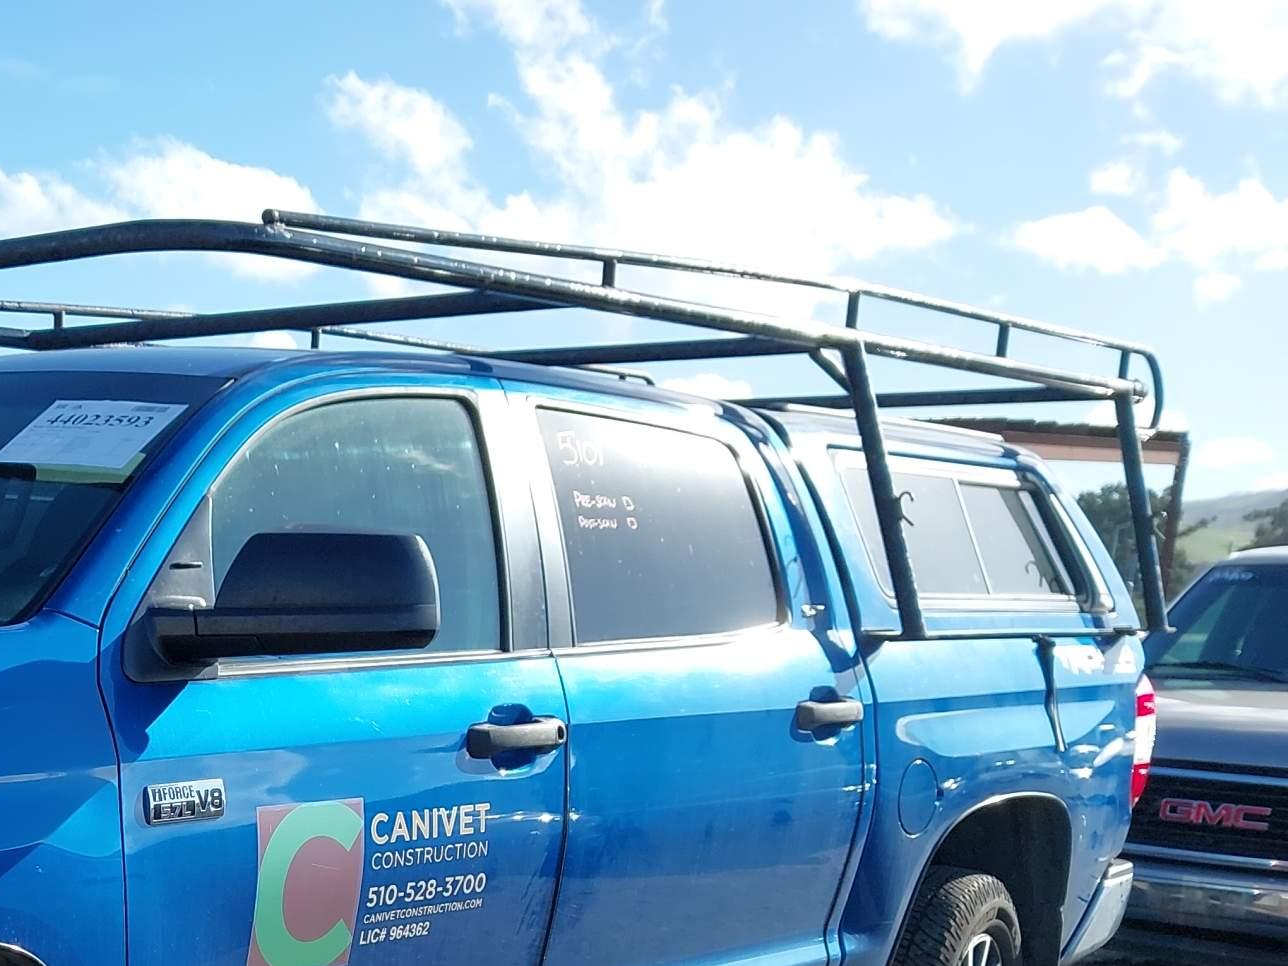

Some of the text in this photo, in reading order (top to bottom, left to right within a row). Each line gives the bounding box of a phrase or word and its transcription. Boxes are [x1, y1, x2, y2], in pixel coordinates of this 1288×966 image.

[47, 413, 155, 428] 44023593
[195, 787, 223, 812] V8
[370, 802, 491, 845] CANIVET
[1159, 797, 1272, 832] GMC
[371, 840, 489, 871] CONSTRUCTION
[366, 872, 487, 908] 510-528-3700
[363, 898, 483, 924] CANIVETCONSTRUCTION.COM
[359, 921, 431, 945] LIC# 964362
